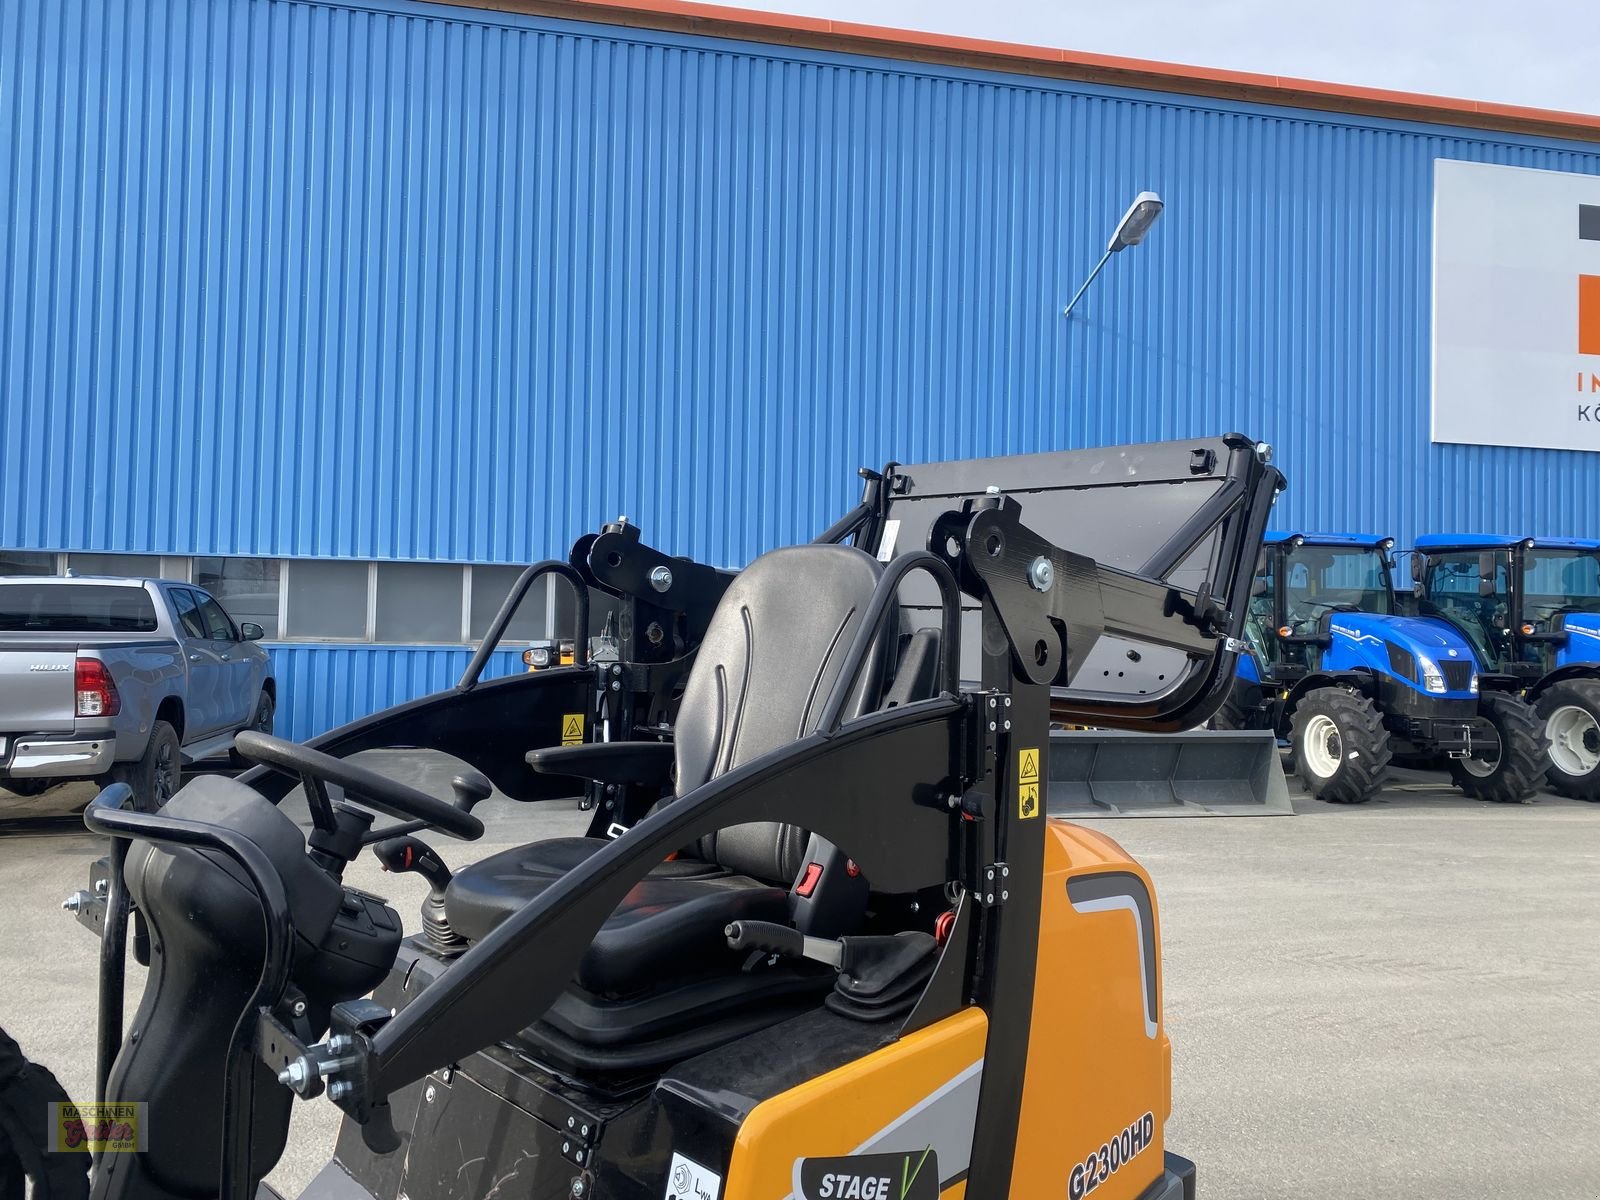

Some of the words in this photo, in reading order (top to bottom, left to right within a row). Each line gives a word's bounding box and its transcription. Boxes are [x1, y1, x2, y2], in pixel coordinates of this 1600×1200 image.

[30, 664, 70, 672] HILUX
[1068, 1111, 1154, 1200] G2300HD
[819, 1173, 891, 1200] STAGE
